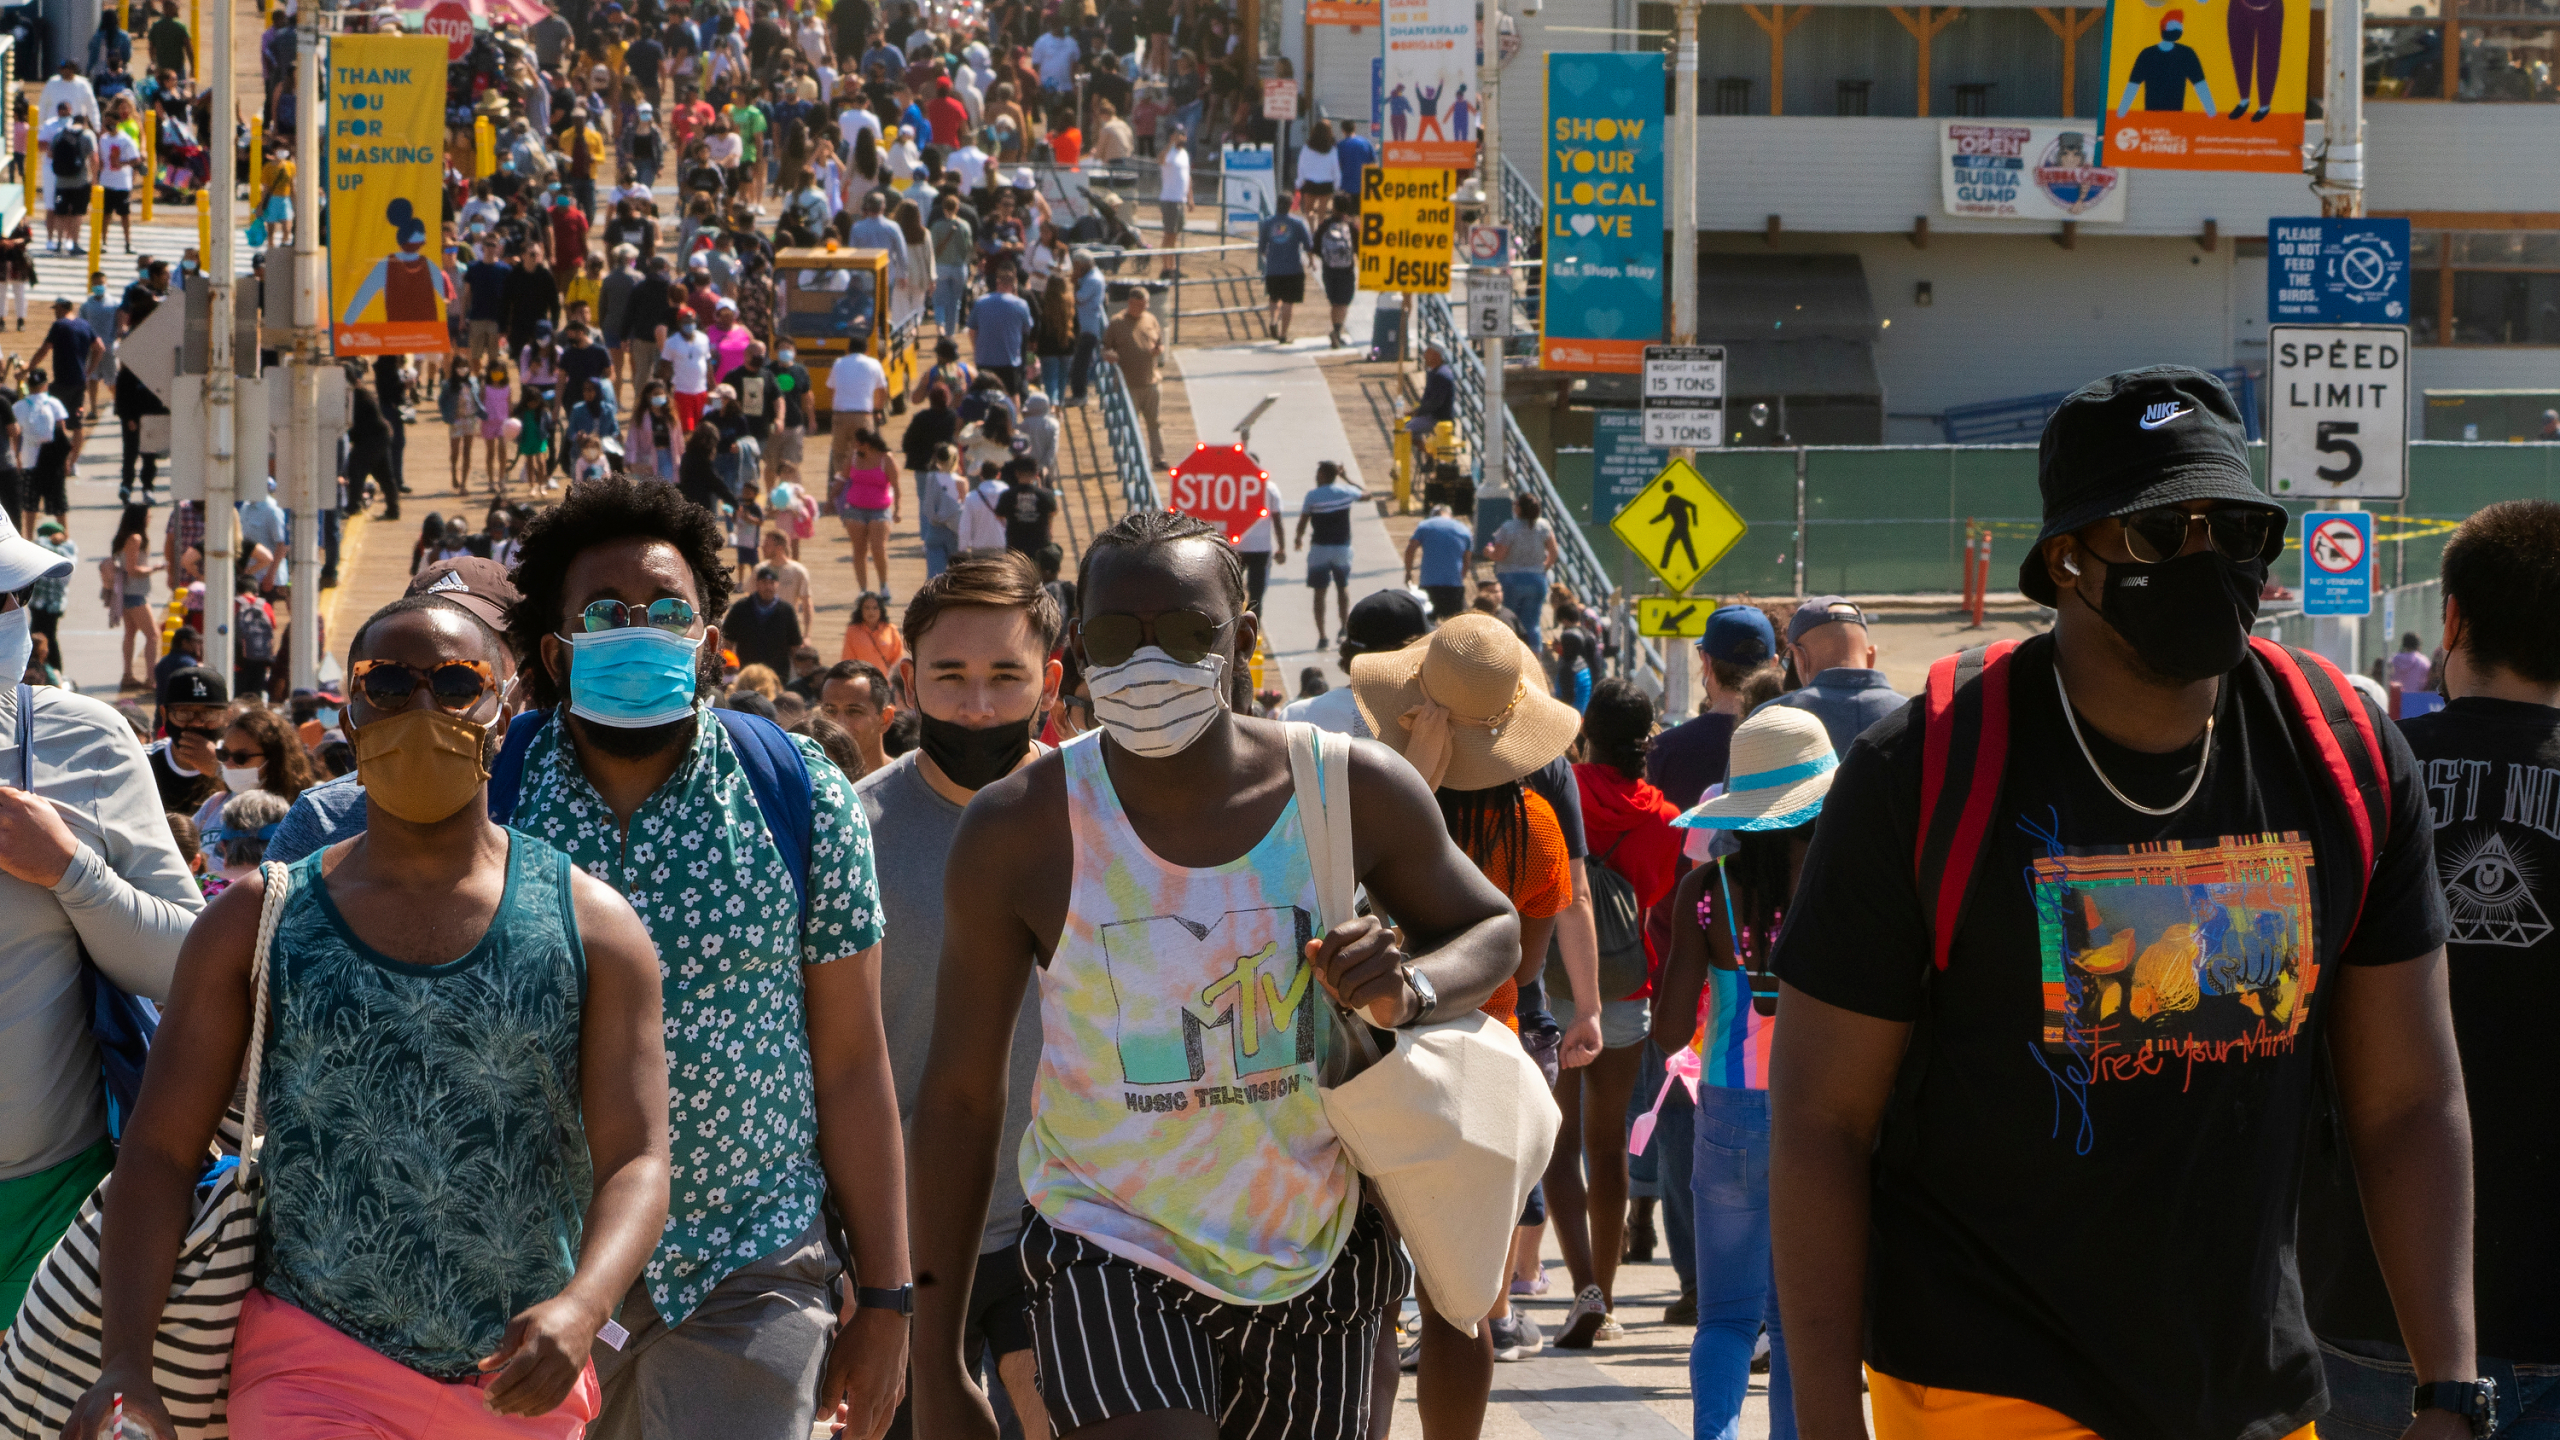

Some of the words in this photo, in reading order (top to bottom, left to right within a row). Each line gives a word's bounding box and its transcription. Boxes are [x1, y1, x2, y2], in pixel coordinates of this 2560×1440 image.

[426, 17, 470, 43] STOP
[337, 68, 412, 84] THANK
[337, 93, 384, 111] YOU
[337, 119, 383, 137] FOR
[1555, 117, 1645, 141] SHOW
[1959, 137, 2021, 155] OPEN
[2141, 142, 2188, 155] SHINES
[337, 147, 434, 164] MASKING
[1556, 150, 1634, 174] YOUR
[337, 174, 363, 190] UP
[1364, 168, 1449, 202] Repent!
[1954, 169, 2020, 187] BUBBA
[1554, 182, 1656, 207] LOCAL
[1957, 187, 2016, 201] GUMP
[1416, 207, 1449, 224] and
[1362, 212, 1448, 247] Believe
[2277, 226, 2322, 240] PLEASE
[2278, 242, 2295, 256] DO
[2297, 242, 2321, 256] NOT
[1361, 252, 1380, 272] in
[1384, 256, 1449, 287] Jesus
[1582, 264, 1621, 278] Shop.
[1625, 265, 1656, 279] Stay
[2284, 258, 2315, 271] FEED
[2288, 273, 2312, 287] THE
[2278, 289, 2319, 302] BIRDS.
[2278, 305, 2301, 314] THANK
[1482, 308, 1499, 331] 5
[2280, 343, 2398, 369] SPEED
[1652, 364, 1688, 373] WEIGHT
[1691, 364, 1716, 373] LIMIT
[1652, 377, 1668, 391] 15
[1675, 377, 1716, 392] TONS
[2290, 383, 2387, 408] LIMIT
[1651, 413, 1687, 421] WEIGHT
[1690, 413, 1716, 422] LIMIT
[2146, 401, 2180, 420] NIKE
[1654, 426, 1666, 440] 3
[1672, 426, 1711, 440] TONS
[2316, 421, 2363, 482] 5
[1175, 473, 1261, 512] STOP
[427, 584, 470, 595] adidas
[2068, 1022, 2163, 1084] Free
[1124, 1091, 1188, 1113] MUSIC
[1194, 1073, 1300, 1108] TELEVISION
